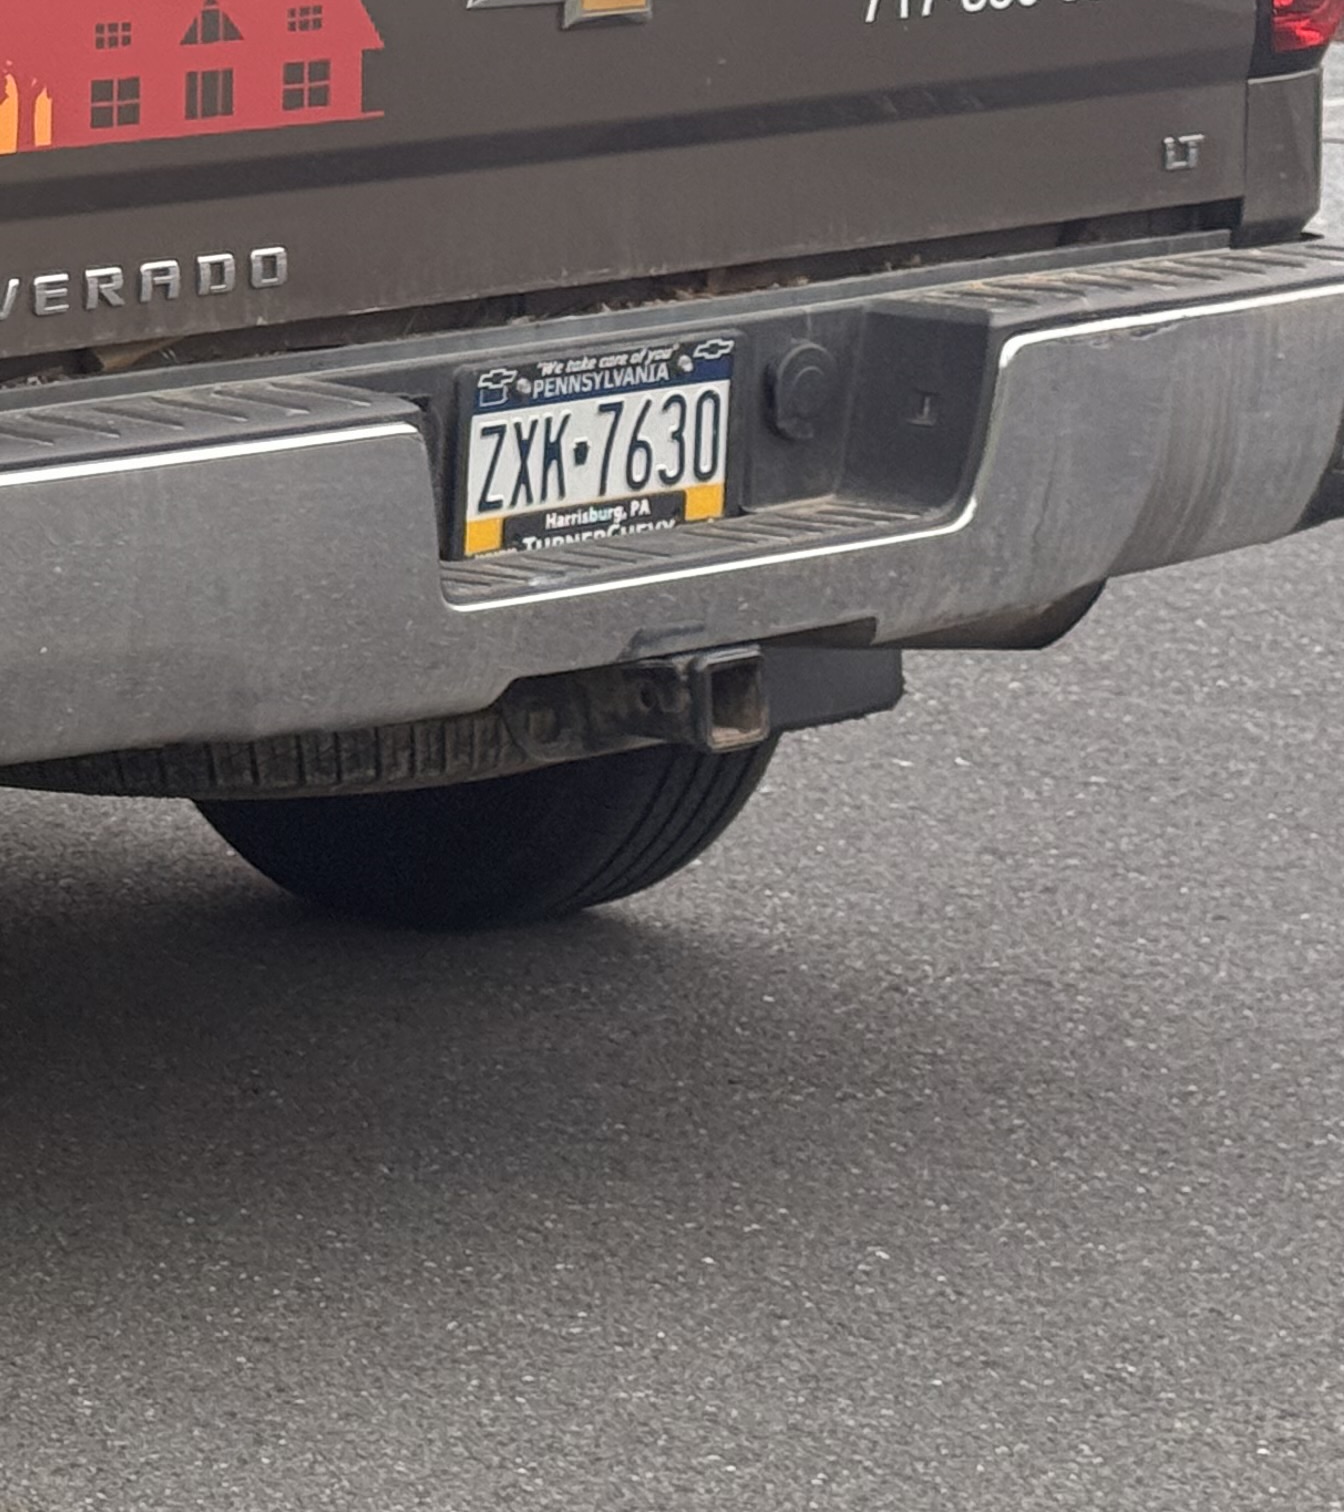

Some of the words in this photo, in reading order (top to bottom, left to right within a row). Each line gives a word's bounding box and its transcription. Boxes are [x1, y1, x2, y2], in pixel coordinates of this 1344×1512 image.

[1161, 133, 1205, 171] LT
[532, 362, 670, 400] PENNSYLVANIA
[545, 504, 627, 530] Harrisburg,
[630, 498, 651, 517] PA
